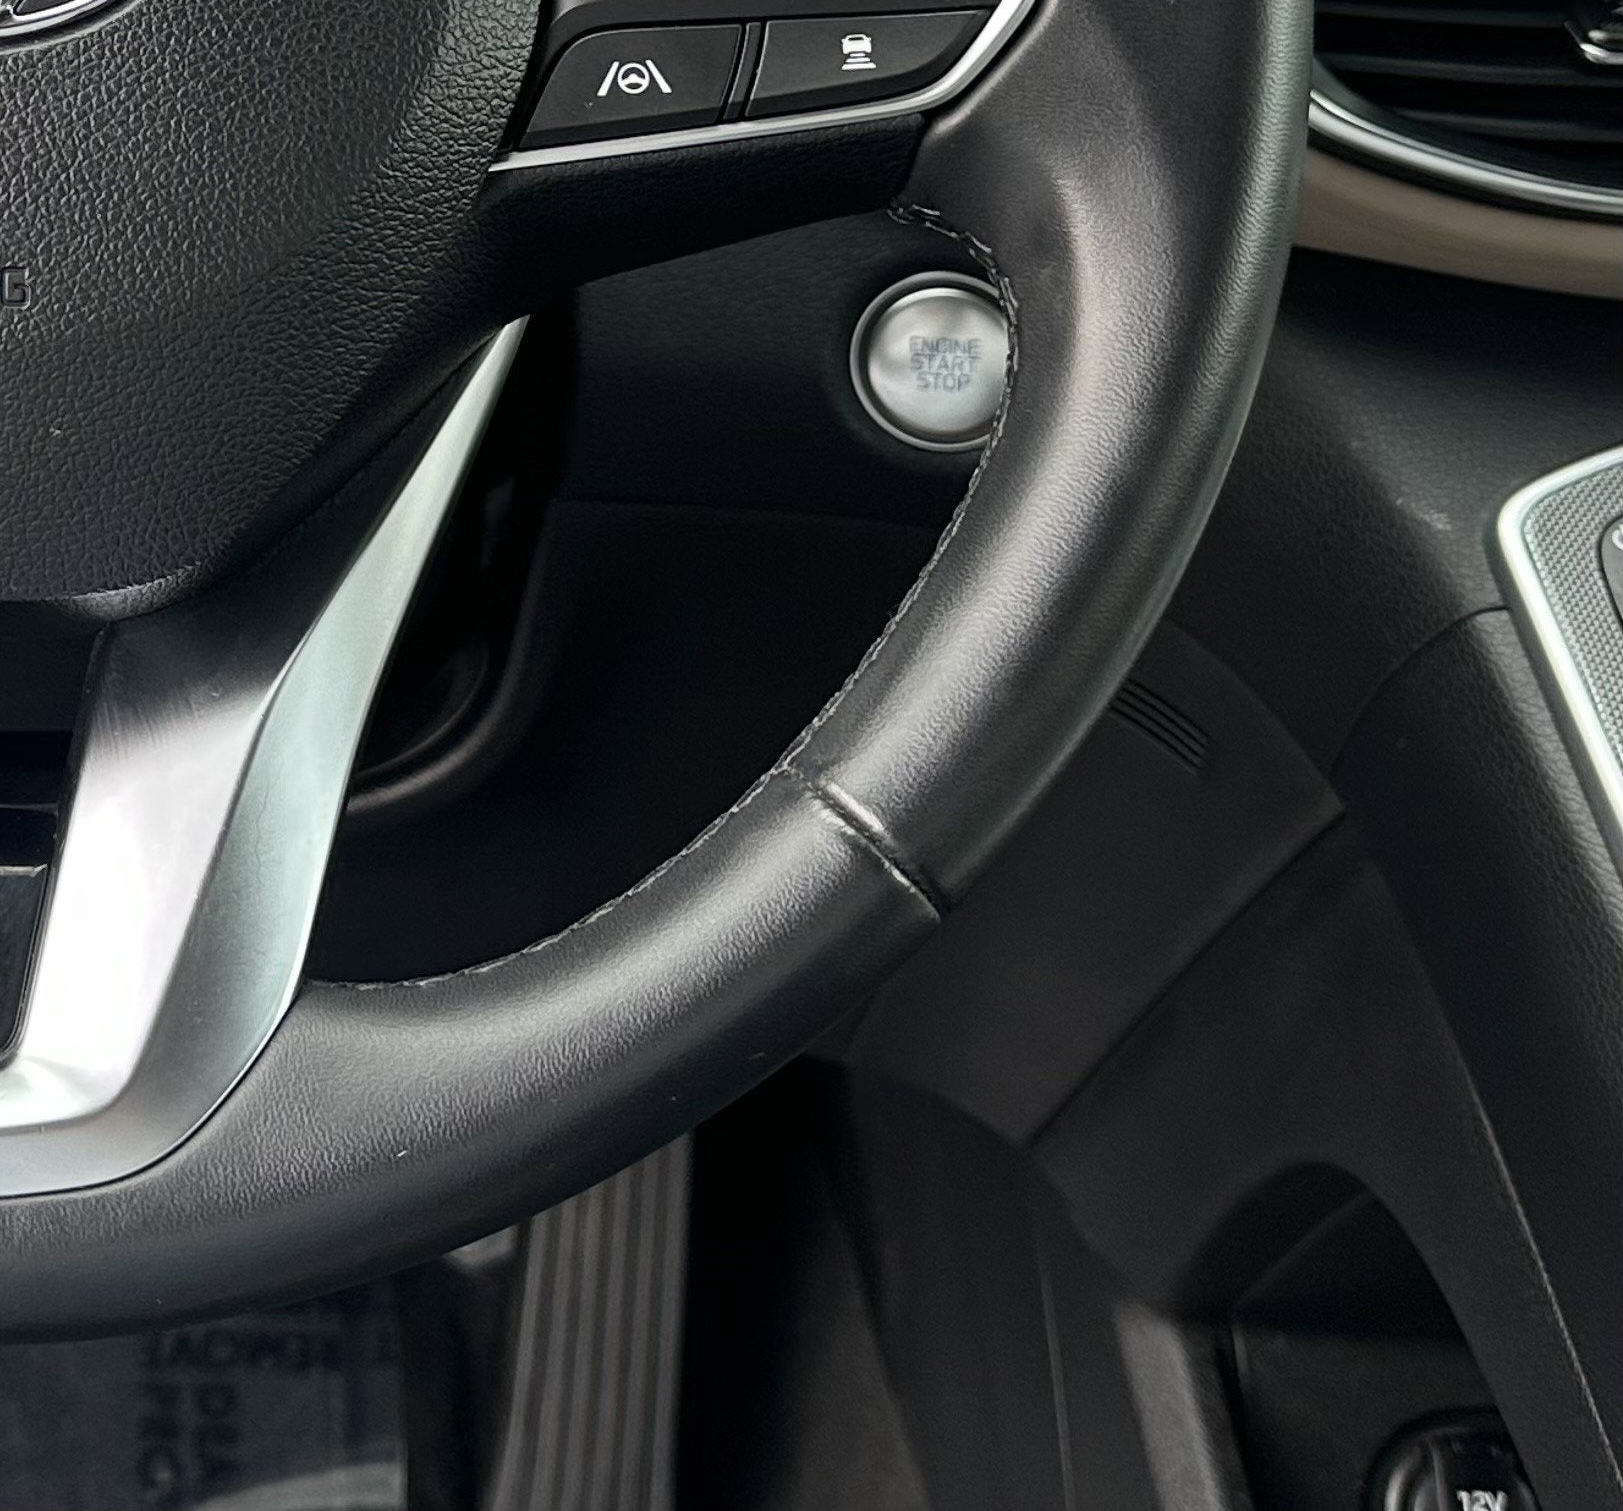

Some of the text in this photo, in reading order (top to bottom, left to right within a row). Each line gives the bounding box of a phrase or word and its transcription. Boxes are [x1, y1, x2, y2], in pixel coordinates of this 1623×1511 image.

[909, 336, 982, 356] ENGINE
[910, 353, 982, 371] START
[916, 373, 971, 392] STOP
